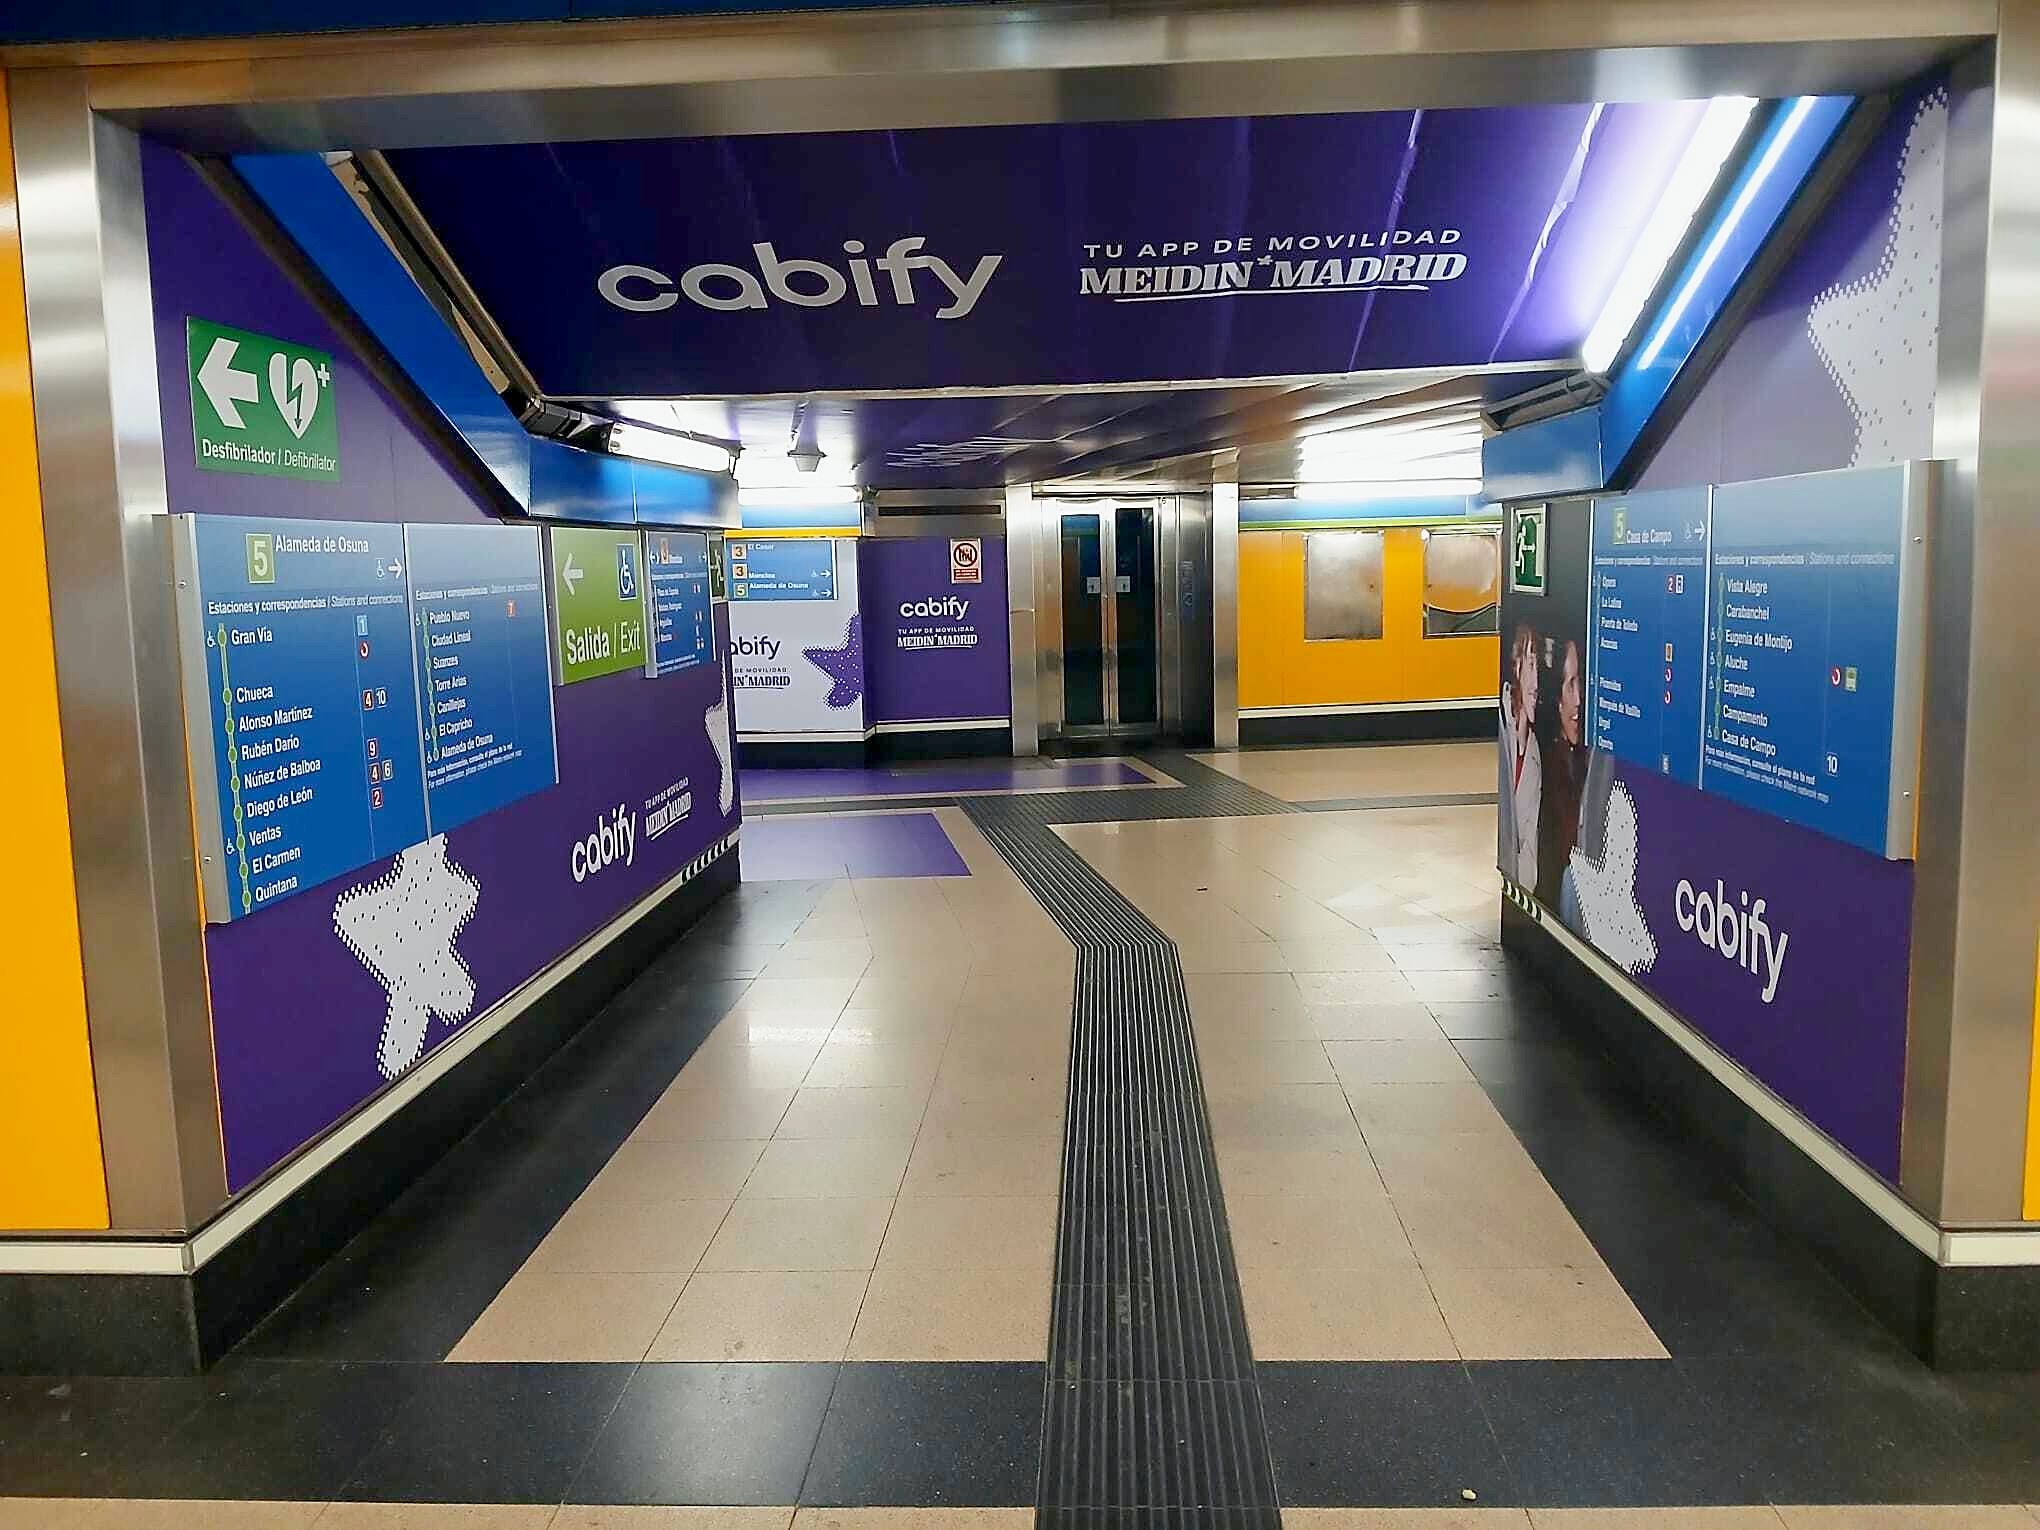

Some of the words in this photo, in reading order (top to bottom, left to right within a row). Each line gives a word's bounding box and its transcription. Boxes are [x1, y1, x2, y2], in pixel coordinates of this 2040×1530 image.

[1084, 244, 1123, 258] TU
[1137, 242, 1199, 257] APP
[1214, 238, 1252, 253] DE
[1268, 230, 1462, 251] MOVILIDAD
[598, 237, 1002, 319] cabify
[1080, 261, 1250, 294] MEIDIN
[1270, 254, 1467, 287] MADRID
[202, 438, 275, 465] Desfibrilador
[285, 450, 336, 471] Defibrillator
[1616, 511, 1624, 539] 5
[275, 536, 321, 553] Alameda
[324, 537, 336, 553] de
[339, 536, 369, 553] Osuna
[736, 546, 743, 557] 3
[254, 541, 269, 576] 5
[736, 566, 744, 577] 3
[737, 584, 745, 596] 5
[1727, 579, 1744, 594] Vista
[1744, 579, 1768, 597] Alegre
[208, 601, 254, 615] Estaciones
[255, 602, 260, 615] y
[262, 598, 326, 613] correspondencias
[900, 596, 969, 621] cabify
[1726, 604, 1770, 621] Carabanchel
[232, 629, 256, 646] Gran
[257, 626, 273, 643] Vía
[566, 626, 610, 665] Salida
[620, 620, 641, 653] Exit
[898, 635, 934, 648] MEIDIN
[937, 634, 978, 645] MADRID
[1726, 630, 1753, 648] Eugenia
[1754, 632, 1764, 647] de
[1764, 634, 1793, 653] Montijo
[730, 636, 781, 660] abify
[1725, 654, 1749, 672] Aluche
[435, 678, 451, 692] Torre
[749, 676, 791, 687] MADRID
[1724, 679, 1756, 699] Empalme
[236, 686, 273, 703] Chueca
[377, 690, 386, 705] 10
[239, 714, 273, 733] Alonso
[274, 706, 313, 726] Martínez
[1723, 704, 1769, 728] Campamento
[439, 724, 446, 737] El
[446, 718, 473, 736] Capricho
[242, 742, 273, 761] Rubén
[275, 736, 300, 754] Darío
[369, 742, 376, 756] 9
[467, 738, 475, 751] de
[1722, 728, 1739, 747] Casa
[1740, 734, 1750, 749] de
[1750, 736, 1776, 758] Campo
[244, 770, 275, 790] Núñez
[276, 766, 289, 782] de
[290, 759, 321, 778] Balboa
[1827, 756, 1838, 774] 10
[247, 798, 275, 819] Diego
[276, 794, 289, 810] de
[290, 786, 313, 805] León
[374, 792, 381, 806] 2
[249, 826, 282, 847] Ventas
[572, 804, 636, 883] cabify
[253, 858, 263, 874] El
[264, 847, 301, 869] Carmen
[256, 876, 298, 903] Quintana
[1676, 880, 1788, 1003] cabify
